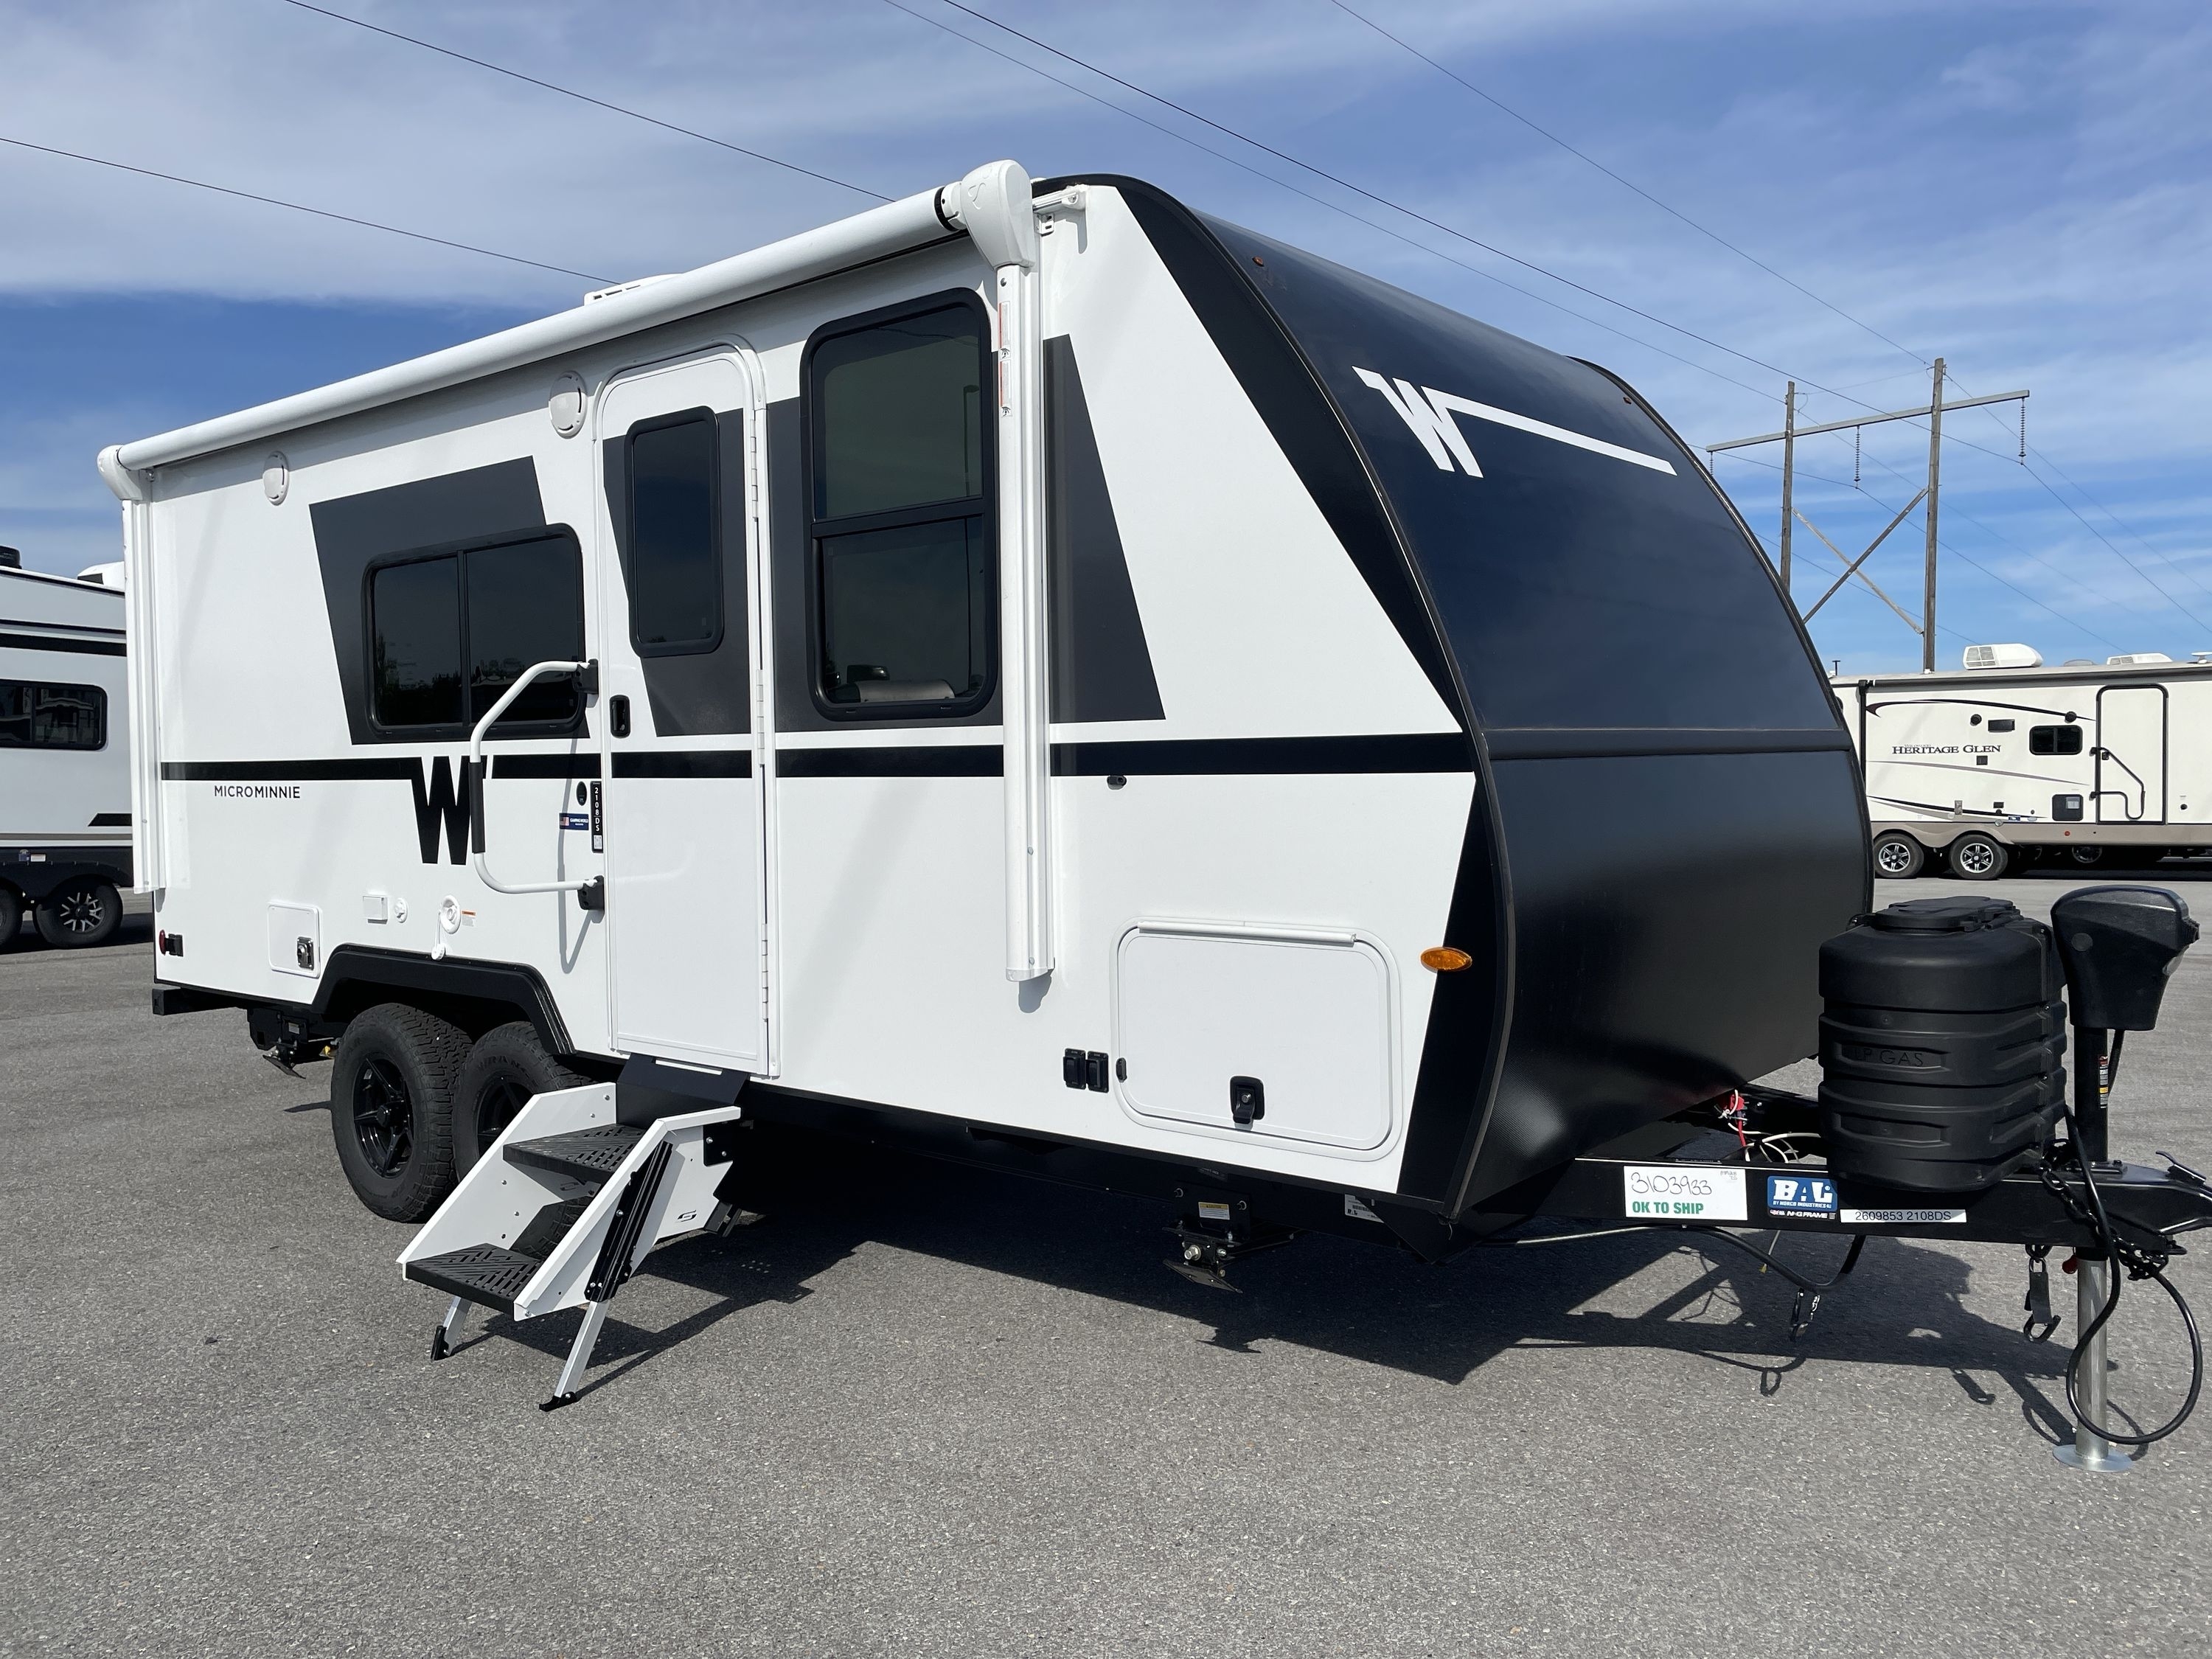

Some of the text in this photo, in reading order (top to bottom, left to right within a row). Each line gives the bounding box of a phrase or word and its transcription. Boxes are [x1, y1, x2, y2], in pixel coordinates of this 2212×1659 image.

[1892, 745, 2001, 754] HERITAGE GLEN
[1854, 1048, 1924, 1067] LP GAS
[1773, 1180, 1833, 1203] BAL
[1632, 1201, 1704, 1214] OK TO SHIP
[1855, 1211, 1952, 1221] 2609853 2108DS
